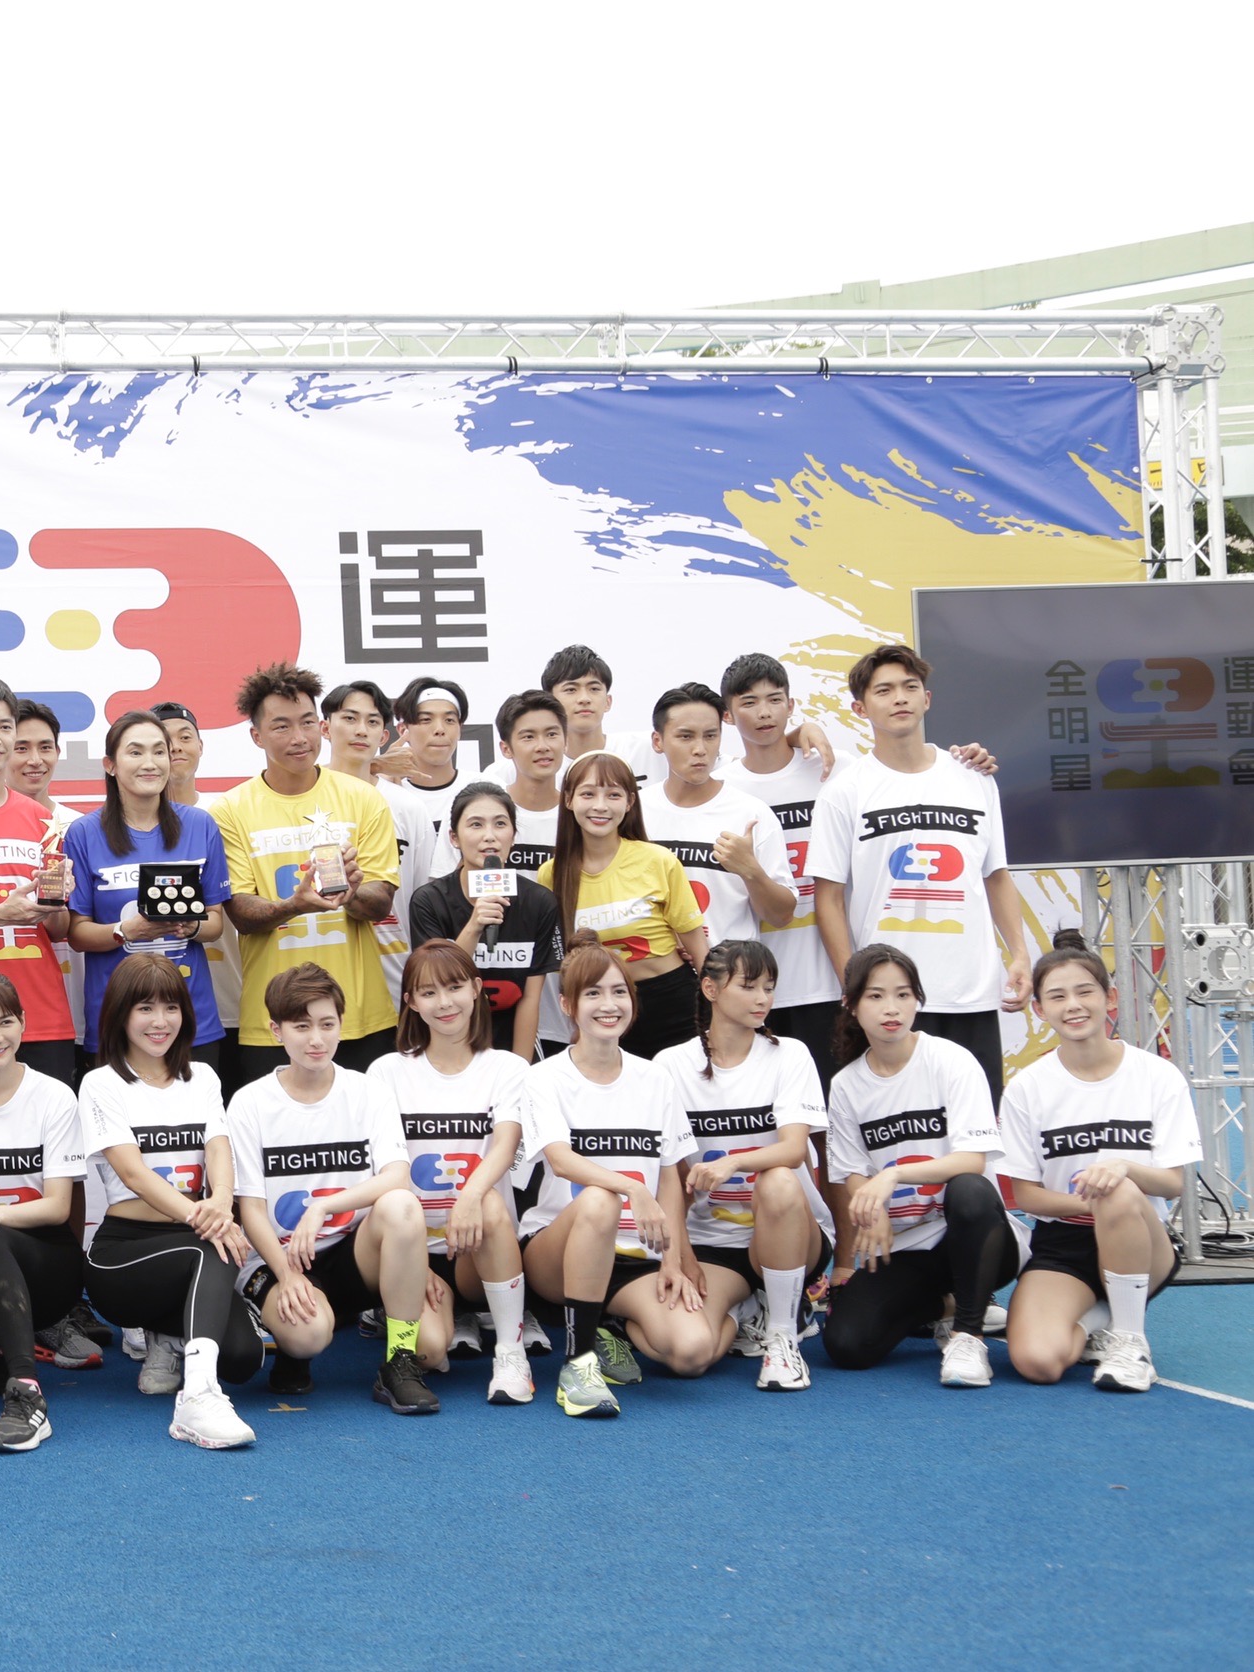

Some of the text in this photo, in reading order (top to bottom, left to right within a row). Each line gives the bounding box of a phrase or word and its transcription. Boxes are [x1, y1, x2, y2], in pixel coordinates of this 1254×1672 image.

[1045, 659, 1092, 792] 全明星
[877, 811, 969, 829] FIGHTING
[264, 828, 342, 848] FIGHTG
[577, 902, 643, 928] GHTING
[137, 1130, 205, 1147] FIGHTIN
[865, 1117, 941, 1144] FIGHTING
[1052, 1127, 1153, 1150] FIGHTING
[268, 1149, 362, 1170] FIGHTING
